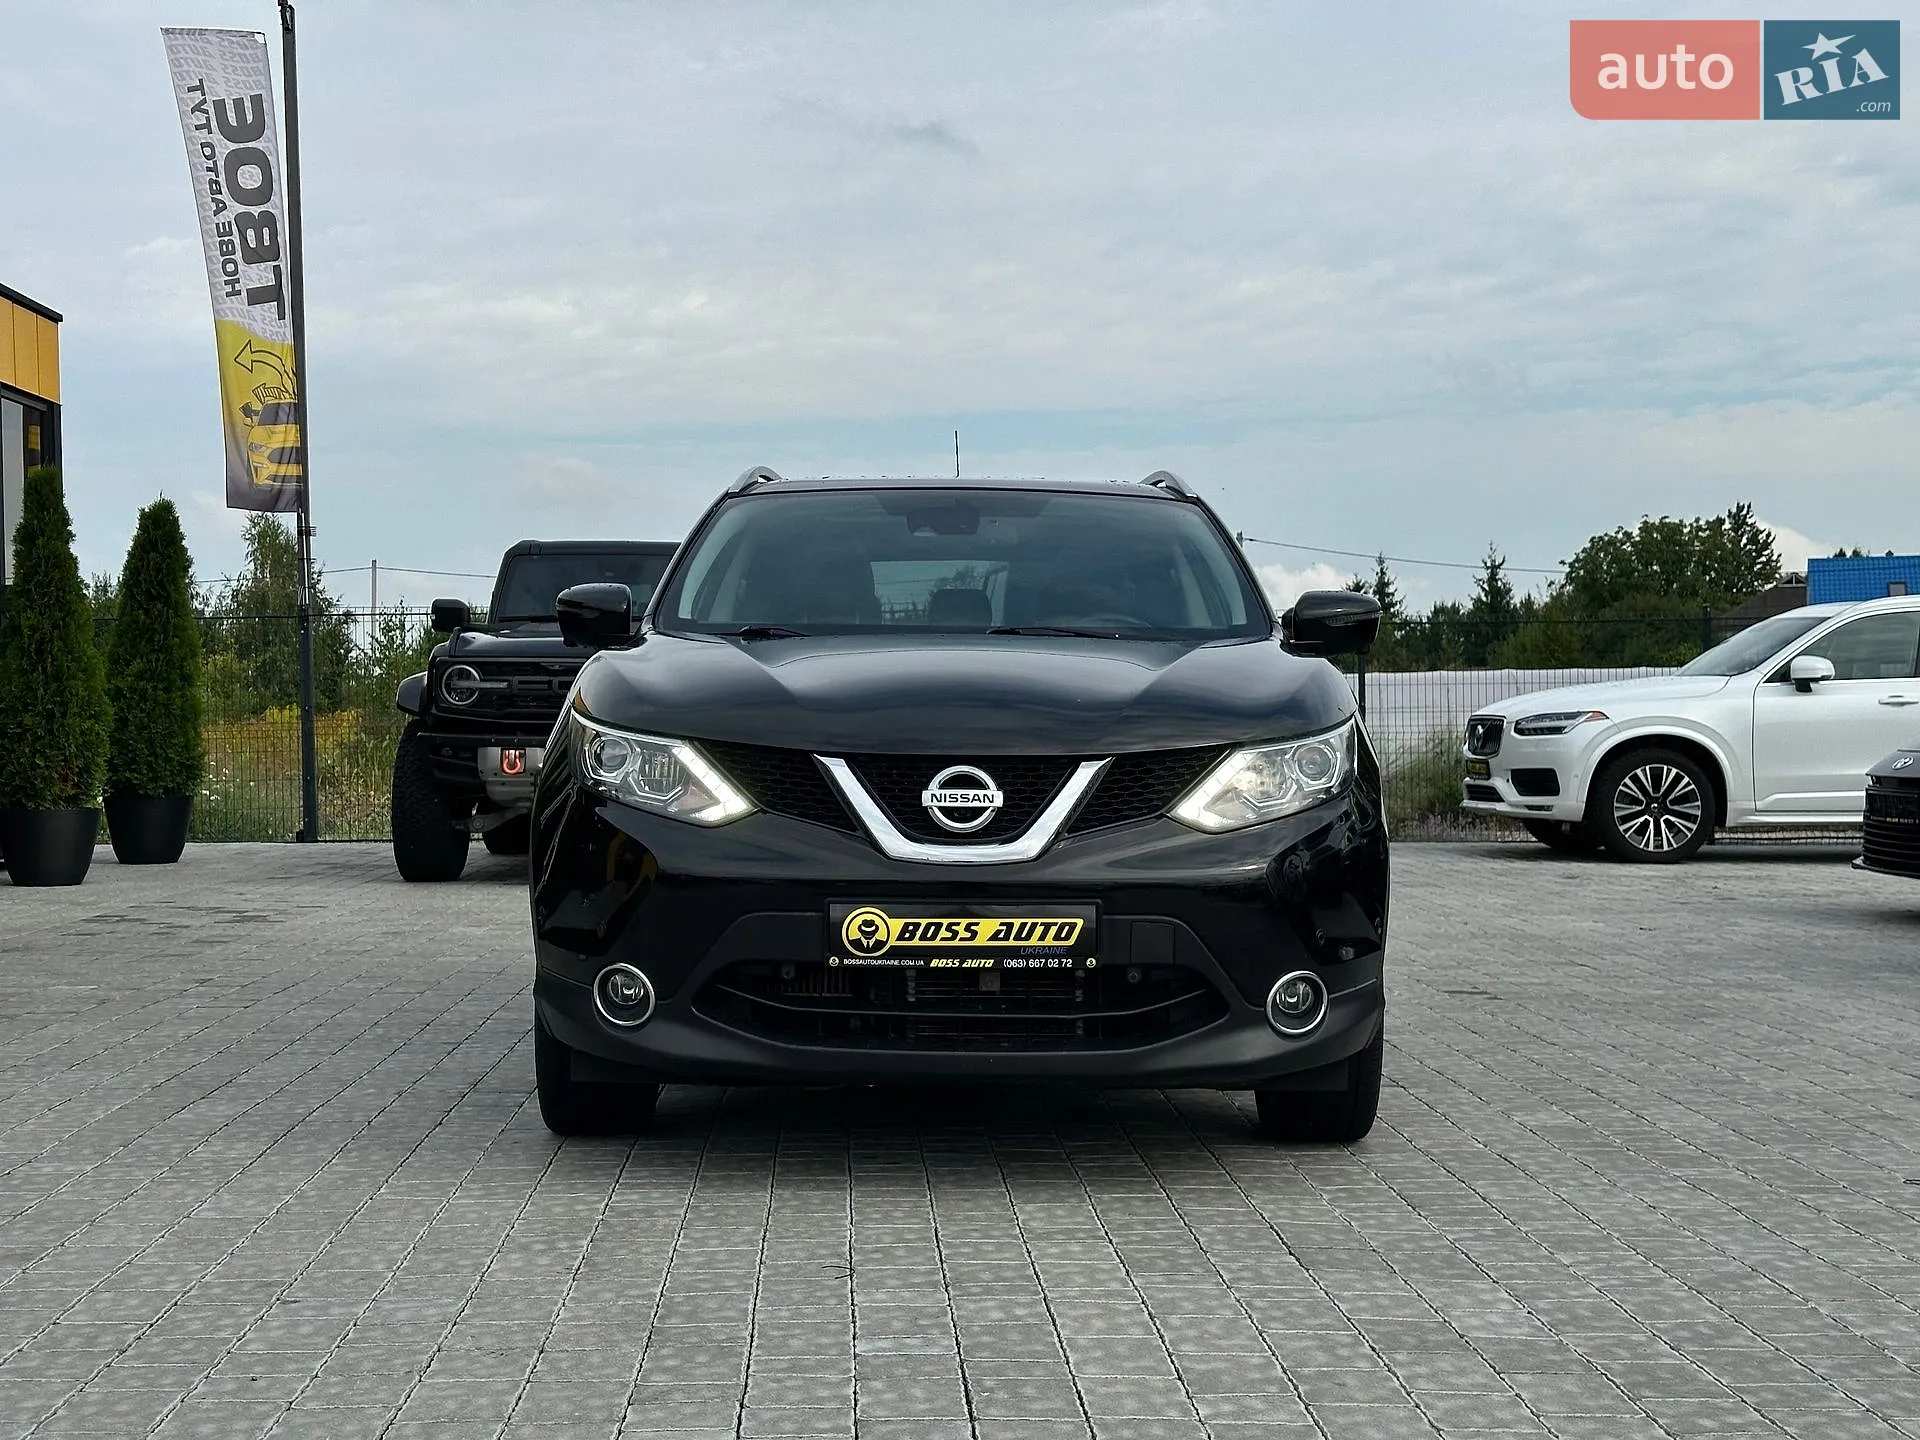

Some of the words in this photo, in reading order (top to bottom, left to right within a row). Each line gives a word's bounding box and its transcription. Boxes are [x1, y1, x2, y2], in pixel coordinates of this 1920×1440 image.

[930, 793, 995, 804] NISSAN
[895, 921, 981, 942] BOSS
[986, 921, 1079, 942] AUTO
[1020, 946, 1068, 955] UKRAINE
[929, 959, 960, 968] BOSS
[961, 959, 995, 968] AUTO
[1003, 958, 1027, 968] (063)
[1028, 958, 1046, 968] 667
[1047, 959, 1059, 968] 02
[1061, 959, 1073, 968] 72
